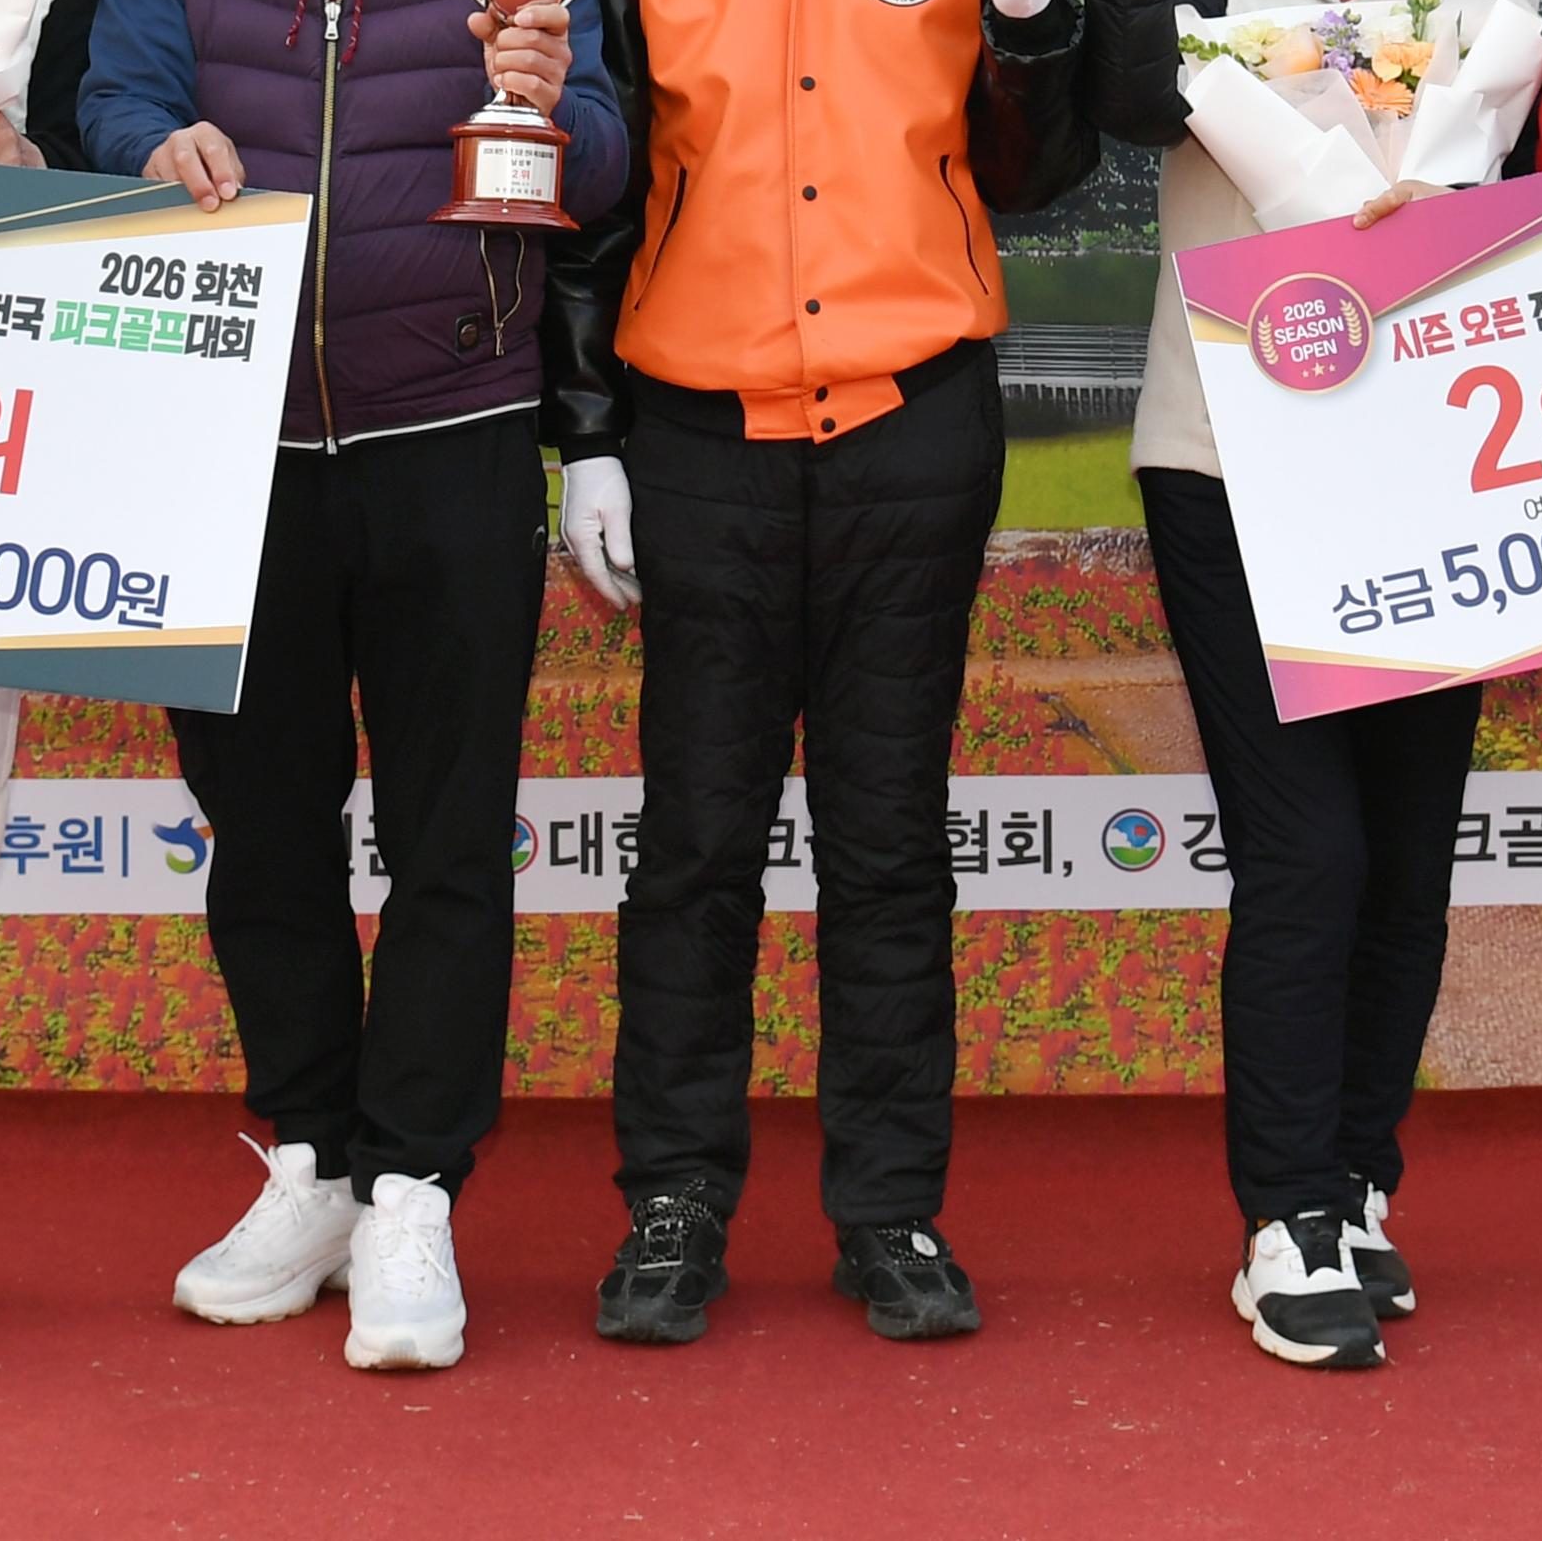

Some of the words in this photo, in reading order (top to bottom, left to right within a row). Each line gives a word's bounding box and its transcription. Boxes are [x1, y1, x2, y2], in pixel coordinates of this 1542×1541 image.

[98, 252, 187, 301] 2026
[191, 260, 264, 310] 화천
[1283, 298, 1327, 323] 2026
[49, 299, 256, 363] 파크골프대회
[1273, 315, 1345, 346] SEASON
[1290, 338, 1338, 363] OPEN
[1391, 312, 1456, 363] 시즌
[1459, 296, 1527, 348] 오픈
[1331, 574, 1436, 636] 상금
[0, 813, 106, 876] 후원
